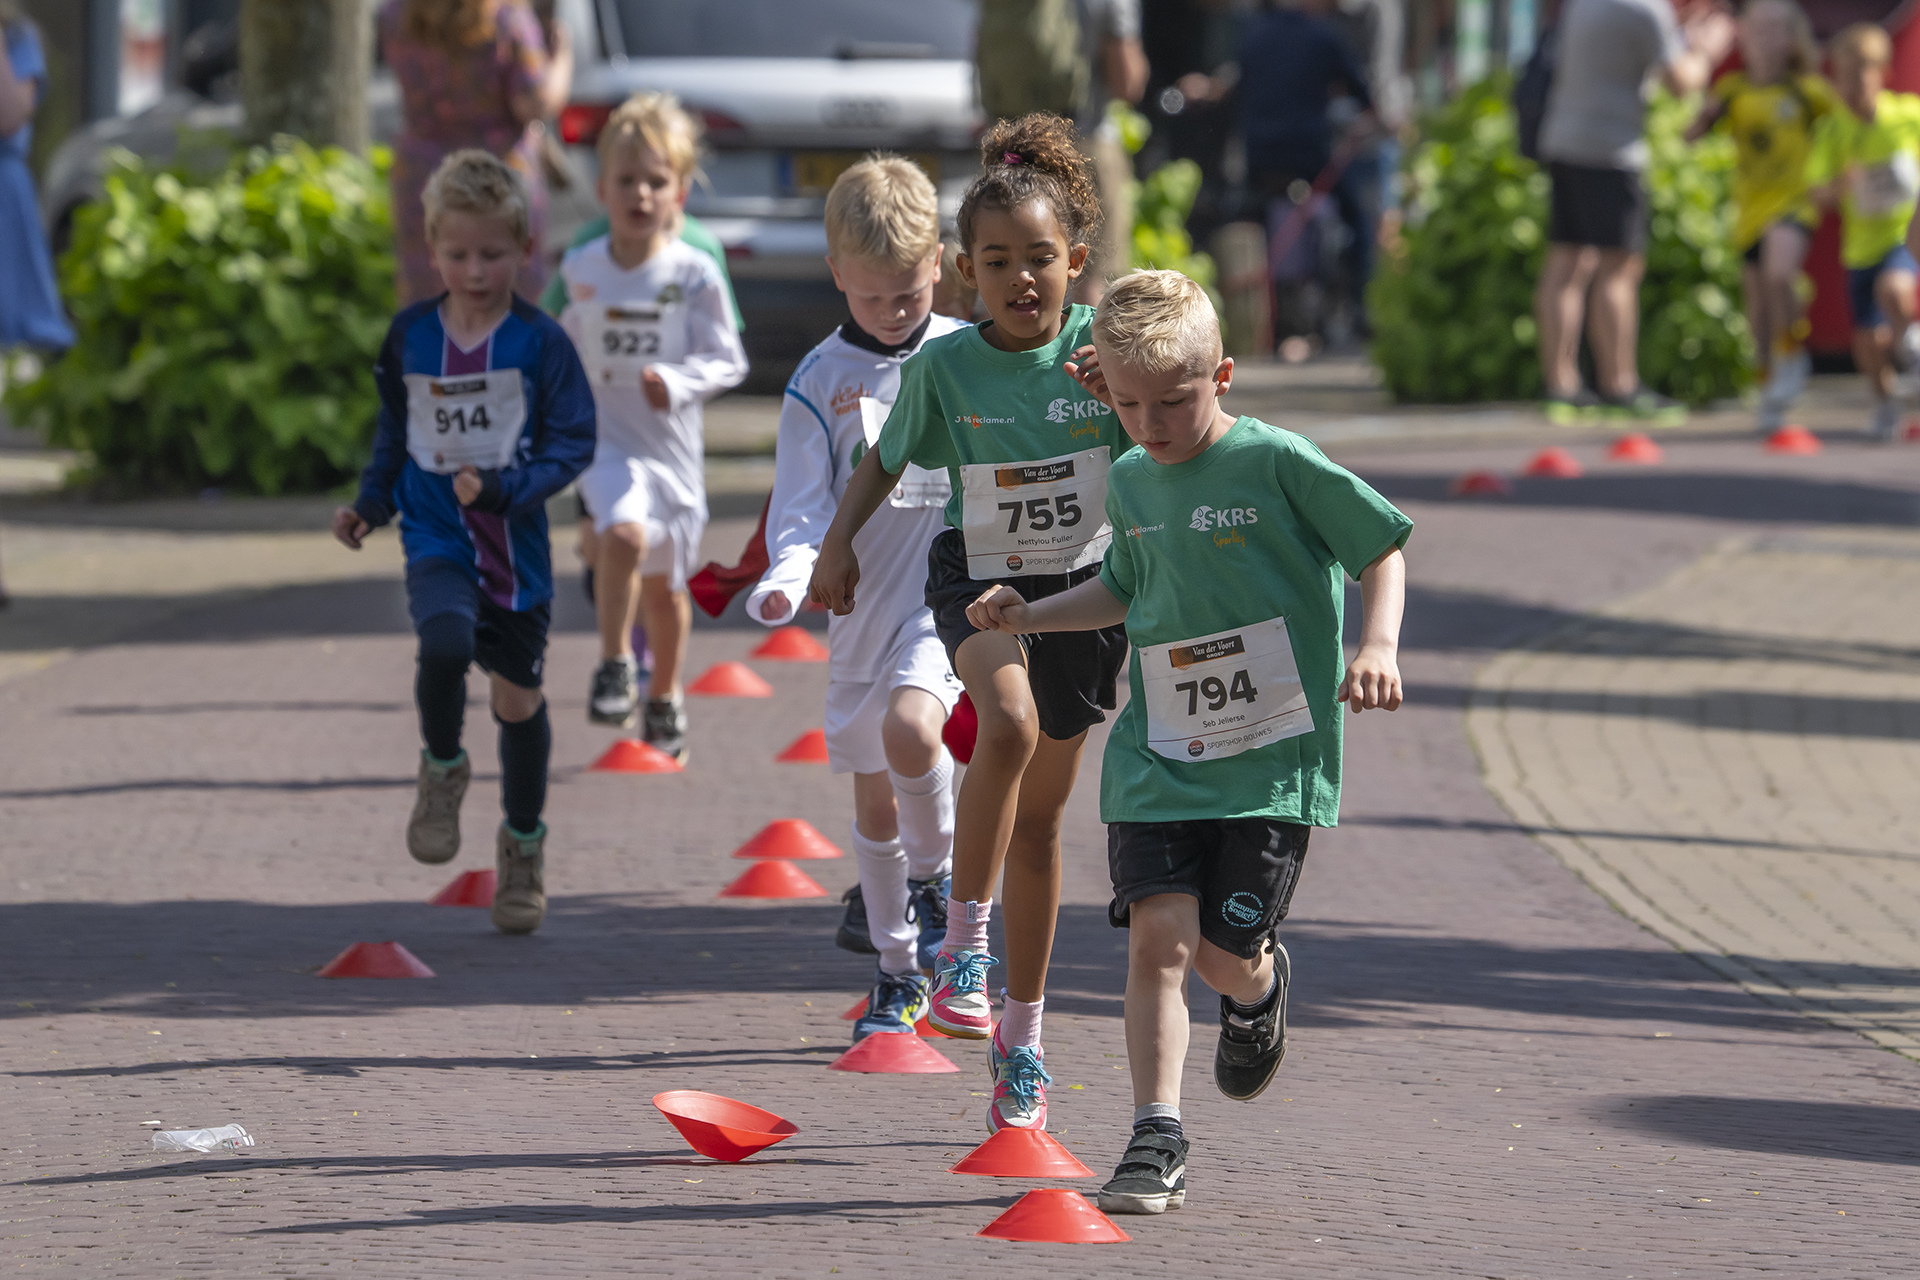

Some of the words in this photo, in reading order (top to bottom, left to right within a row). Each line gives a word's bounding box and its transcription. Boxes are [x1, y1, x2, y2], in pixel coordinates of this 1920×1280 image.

[602, 330, 659, 355] 922
[435, 405, 491, 434] 914
[1055, 399, 1112, 421] SKRS
[1023, 468, 1036, 478] Van
[1037, 466, 1049, 477] der
[1050, 464, 1067, 475] Voort
[997, 492, 1082, 534] 755
[1199, 507, 1258, 529] SKRS
[1017, 537, 1050, 547] Nettylou
[1051, 534, 1074, 544] Fuller
[1025, 557, 1063, 566] SPORTSHOP
[1192, 646, 1205, 656] Van
[1205, 643, 1216, 654] der
[1217, 640, 1235, 651] Voort
[1206, 651, 1225, 659] GROEP
[1175, 669, 1258, 716] 794
[1202, 719, 1216, 729] Seb
[1217, 714, 1246, 726] Jellerse
[1207, 737, 1243, 750] SPORTSHOP
[1243, 727, 1273, 743] BOUWES
[1227, 897, 1263, 916] Summer
